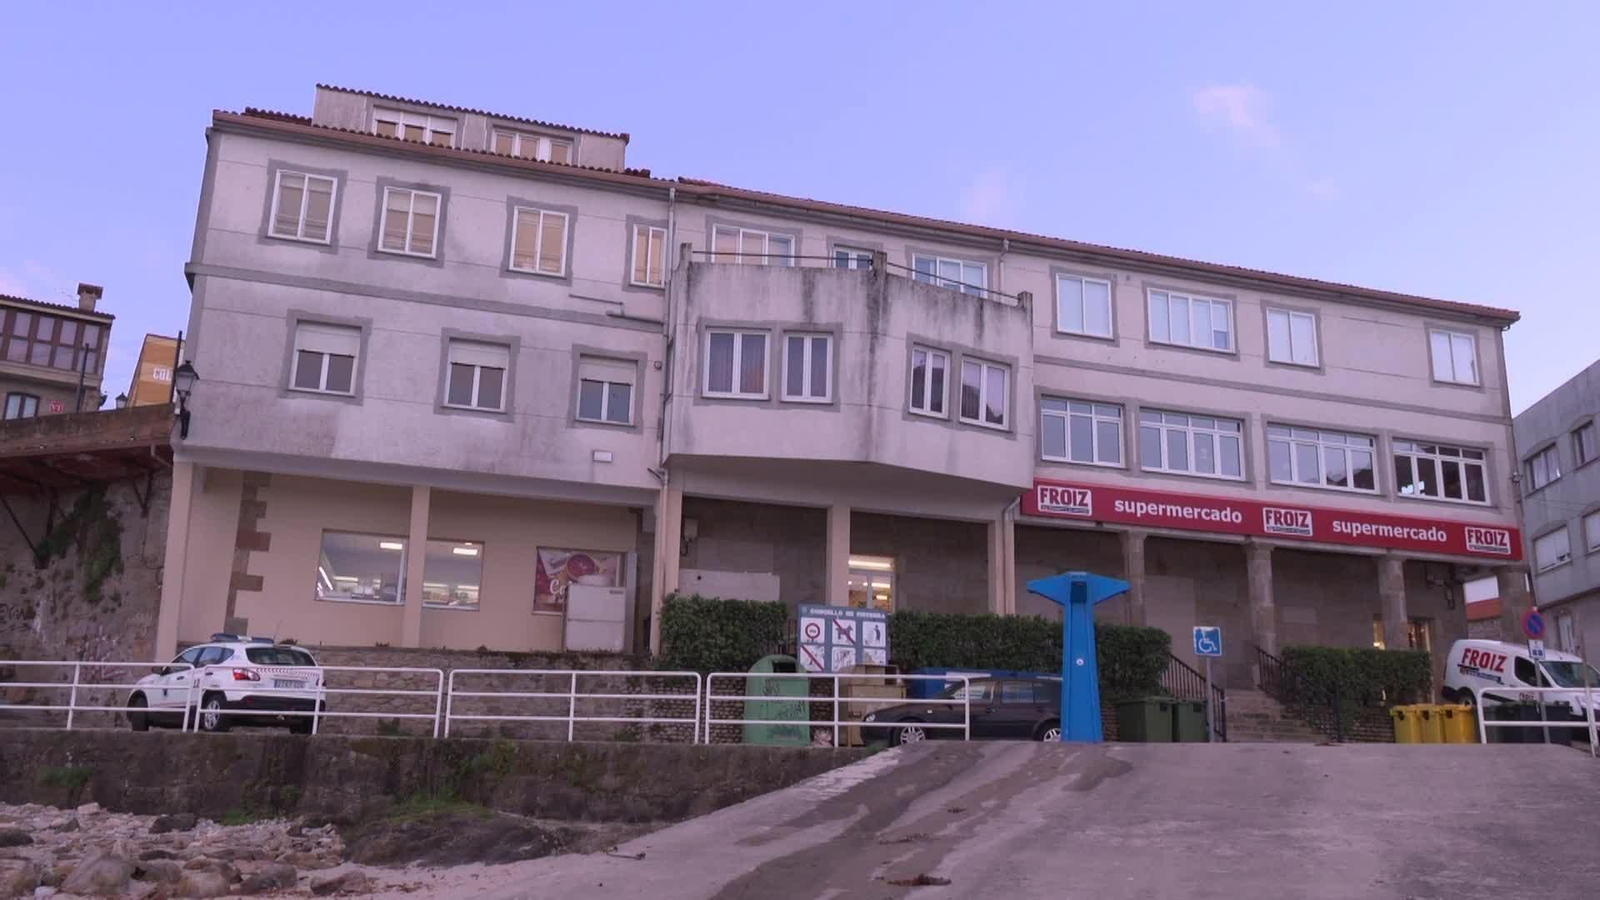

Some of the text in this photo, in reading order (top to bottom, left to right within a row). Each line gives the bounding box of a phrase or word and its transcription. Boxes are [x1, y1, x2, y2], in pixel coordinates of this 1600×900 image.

[1040, 487, 1089, 507] FROIZ
[1114, 499, 1243, 524] supermercado
[1265, 509, 1309, 528] FROIZ
[1332, 519, 1447, 542] supermercado
[1467, 529, 1508, 547] FROIZ
[1461, 648, 1507, 673] FROIZ
